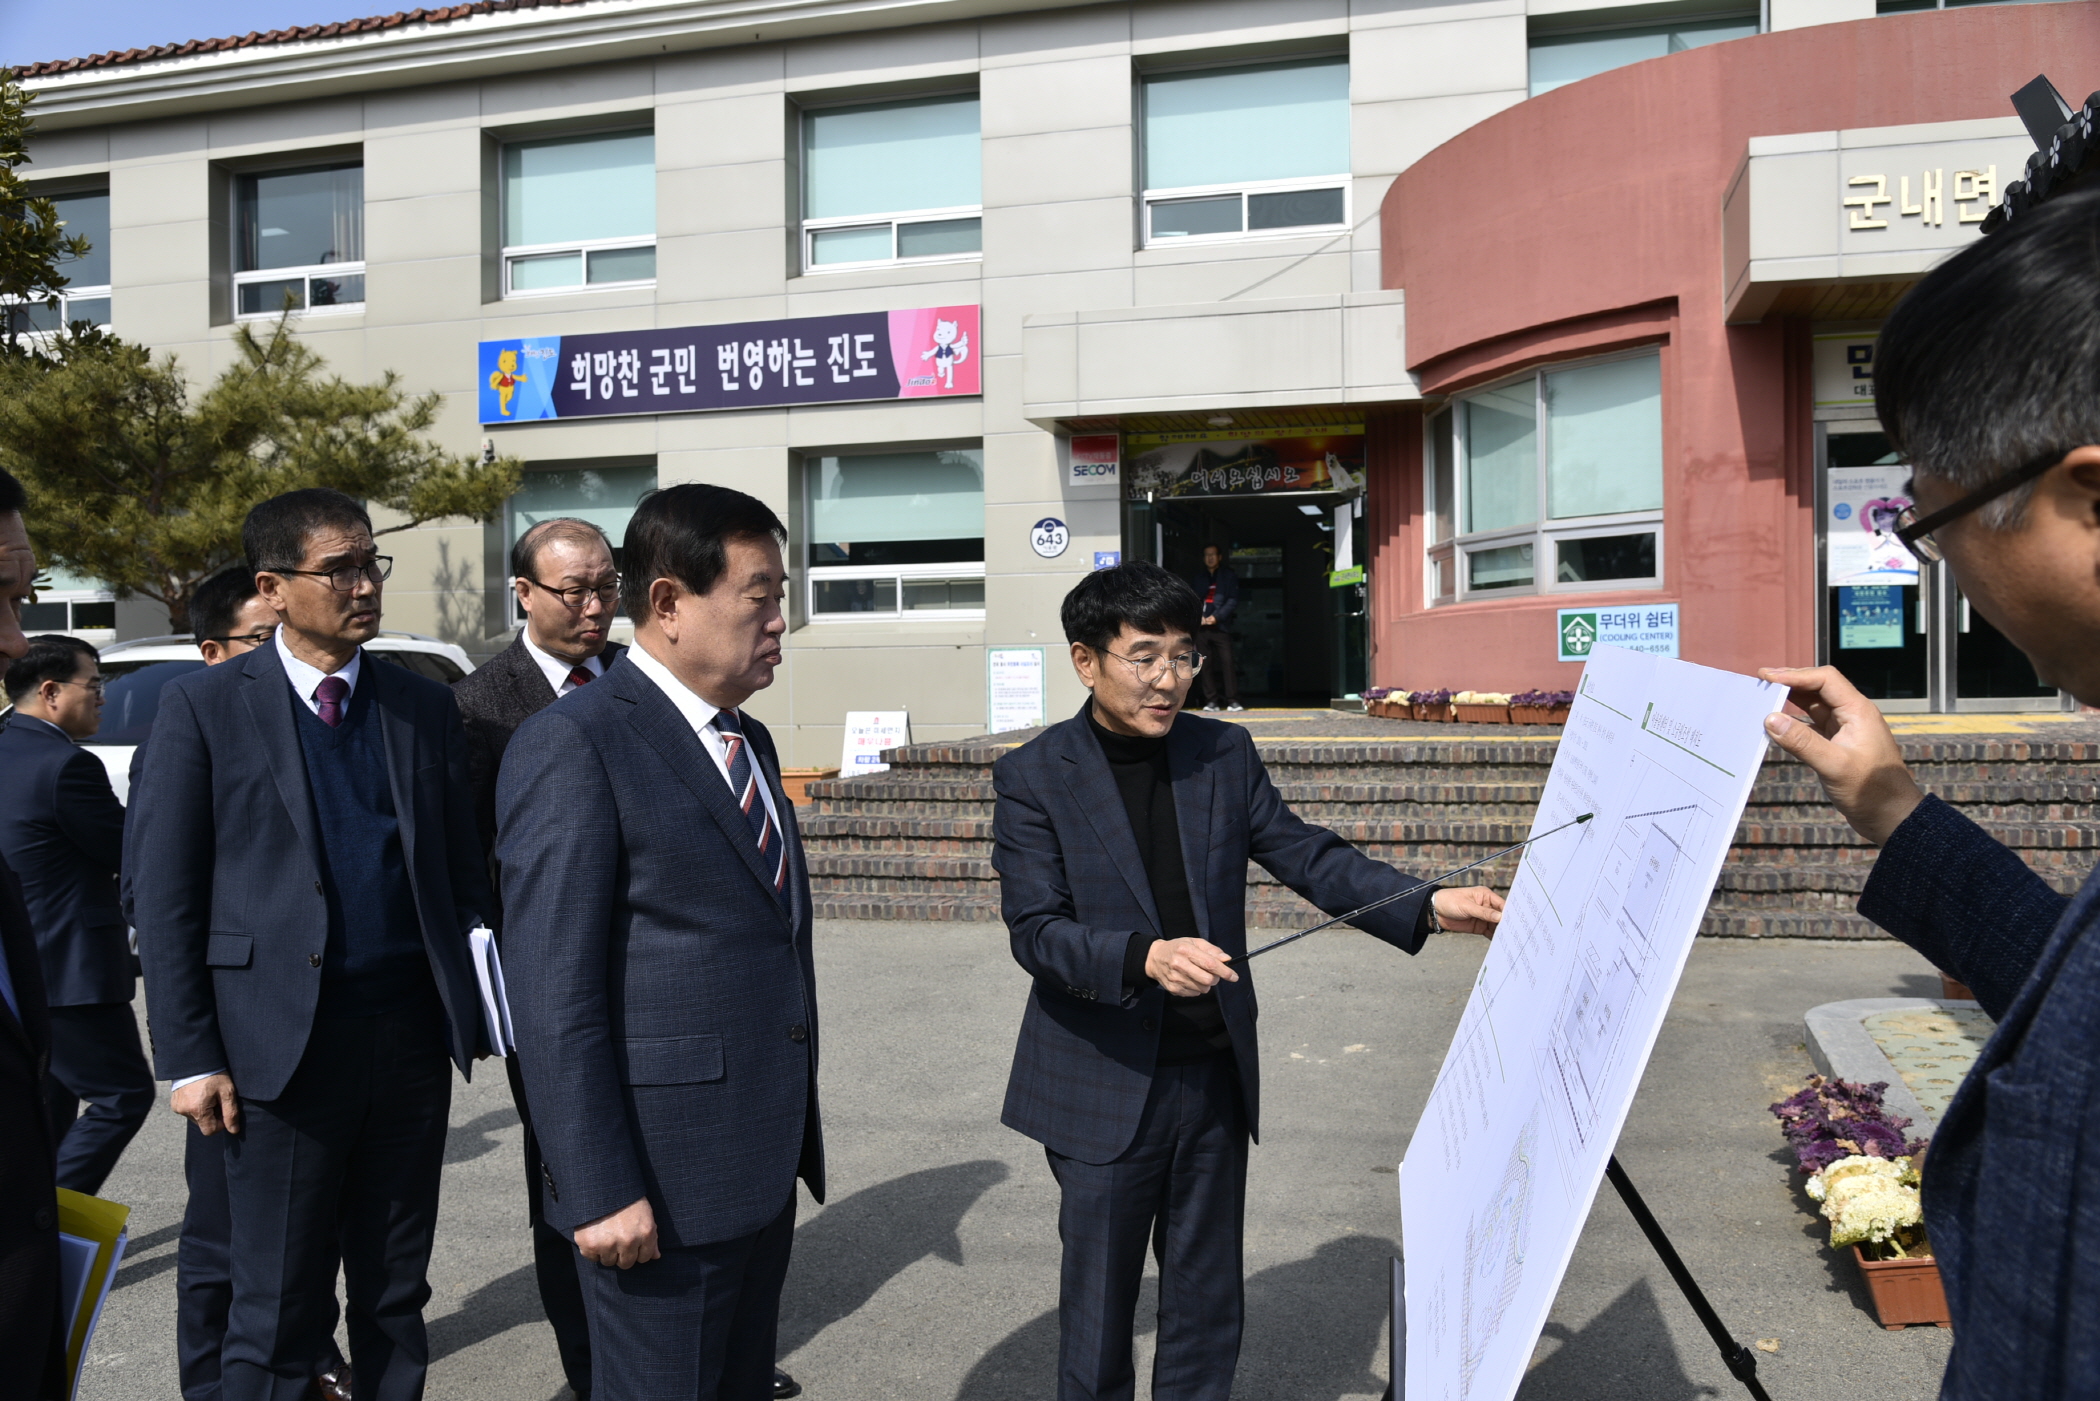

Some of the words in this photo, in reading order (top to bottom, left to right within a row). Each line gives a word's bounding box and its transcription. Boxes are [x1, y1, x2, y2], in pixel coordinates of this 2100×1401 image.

[1844, 165, 1997, 231] 군내면
[570, 348, 641, 400] 희망찬
[650, 345, 696, 396] 군민
[717, 338, 816, 391] 번영하는
[827, 333, 878, 384] 진도
[1073, 463, 1116, 477] SECOM
[1191, 464, 1300, 491] 어서오십시오
[1036, 533, 1063, 546] 643
[1599, 612, 1641, 630] 무더위
[1645, 611, 1673, 628] 쉼터
[1640, 632, 1673, 640] CENTER)
